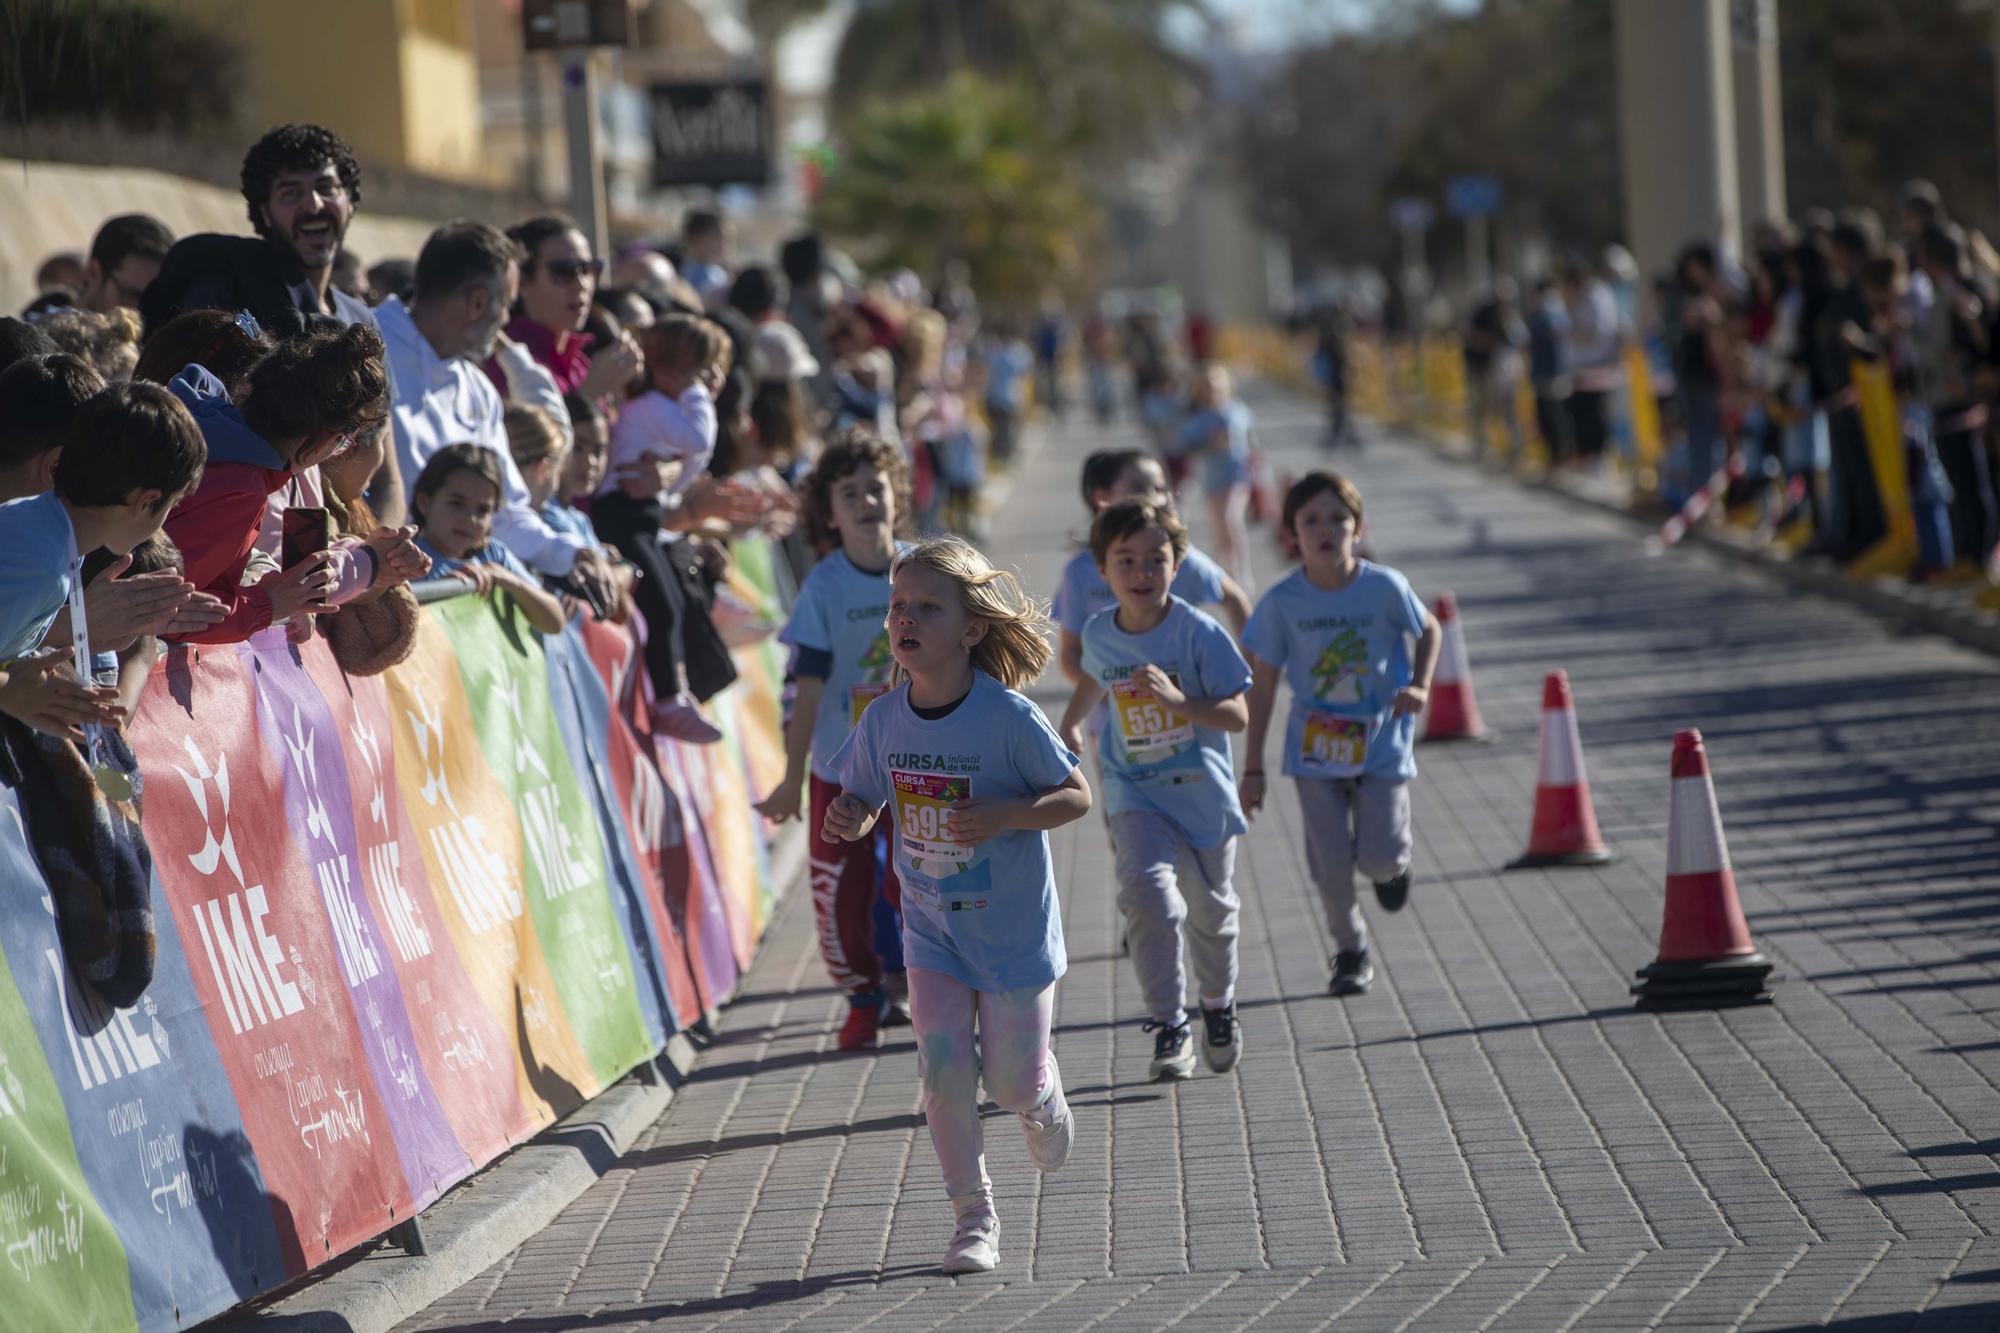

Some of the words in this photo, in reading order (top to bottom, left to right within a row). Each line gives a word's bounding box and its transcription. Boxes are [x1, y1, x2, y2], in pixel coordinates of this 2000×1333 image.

[888, 753, 946, 771] CURSA
[895, 774, 926, 786] CURSA
[961, 764, 980, 772] Reis
[429, 815, 523, 935] IME
[520, 783, 591, 901] IME
[904, 802, 957, 841] 595
[192, 884, 305, 1034] IME
[317, 854, 380, 987] IME
[369, 841, 431, 963] IME
